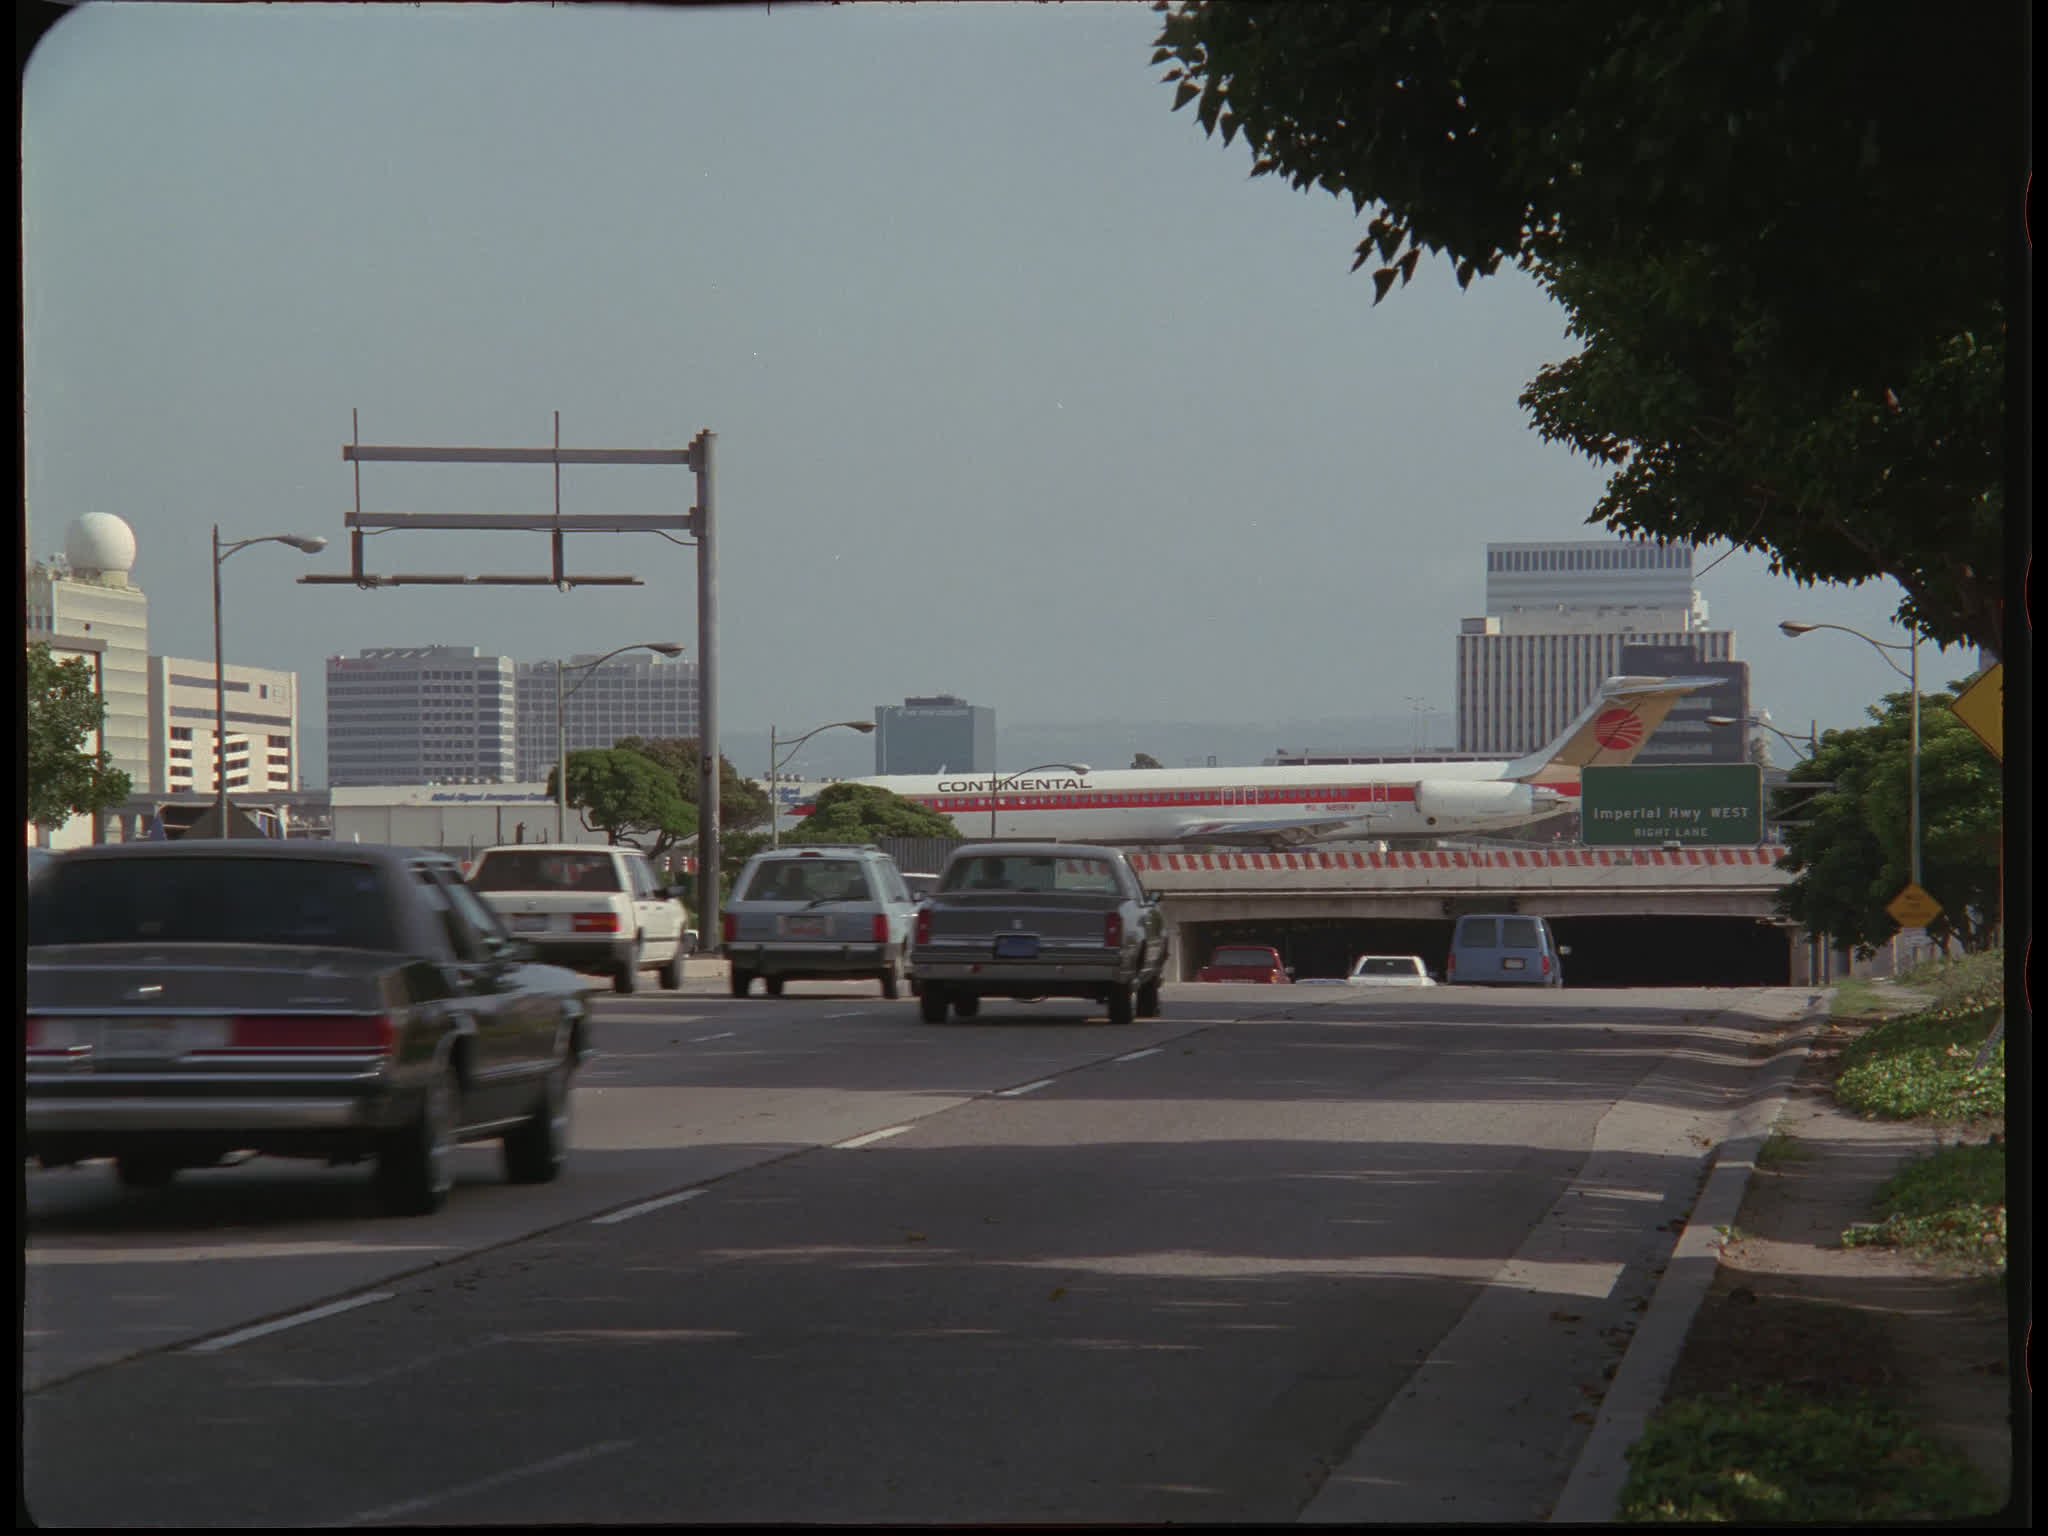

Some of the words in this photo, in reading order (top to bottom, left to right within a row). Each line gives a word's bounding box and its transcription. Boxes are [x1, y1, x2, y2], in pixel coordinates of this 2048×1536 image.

[938, 778, 1092, 792] CONTINENTAL
[1593, 807, 1661, 821] Imperial
[1669, 807, 1701, 822] Hwy
[1710, 807, 1749, 818] WEST
[1634, 827, 1671, 838] RIGHT
[1675, 827, 1709, 838] LANE
